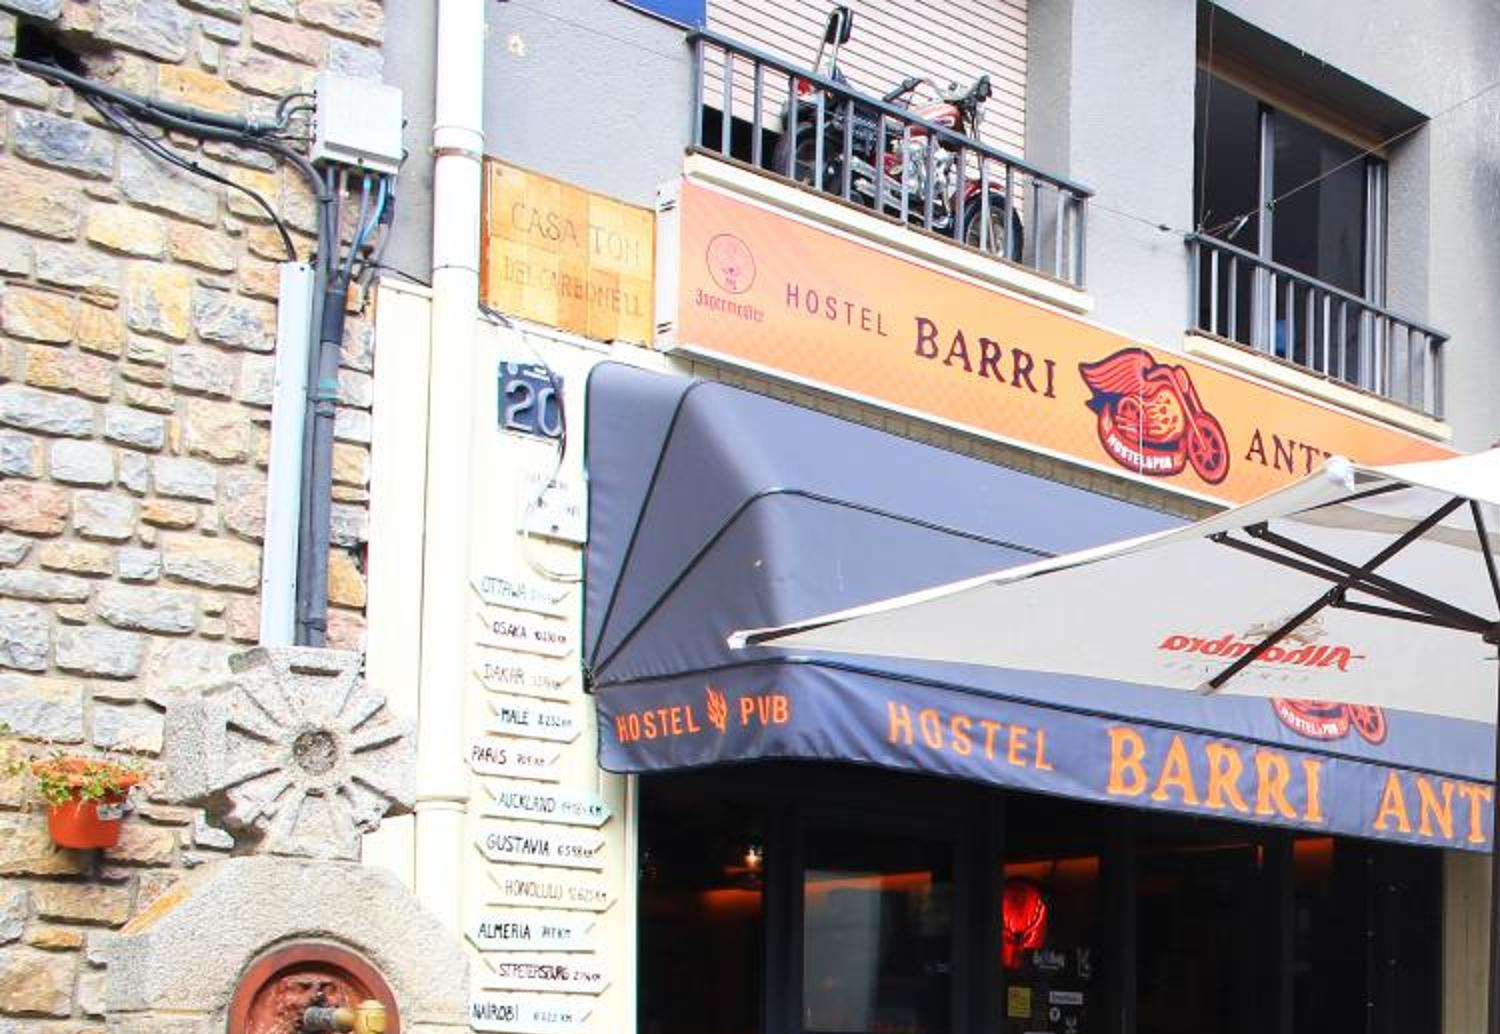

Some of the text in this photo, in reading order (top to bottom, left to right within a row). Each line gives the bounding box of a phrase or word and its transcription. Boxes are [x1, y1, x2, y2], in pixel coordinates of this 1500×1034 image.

[510, 202, 578, 243] CASA
[786, 282, 1355, 476] HOSTEL BARRI ANT
[505, 379, 563, 438] 20
[492, 620, 528, 639] OSAKA
[483, 662, 527, 686] DAKAR
[500, 707, 529, 726] MALE
[614, 695, 792, 743] HOSTEL PUB
[471, 744, 508, 766] PARIS
[887, 701, 1056, 772] HOSTEL
[1106, 726, 1325, 825] BARRI
[497, 792, 557, 814] AUCKLAND
[486, 833, 551, 857] GUSTAVIA
[505, 879, 564, 902] HONOLULU
[477, 923, 532, 941] ALMERIA
[472, 1003, 520, 1022] NAIROBI
